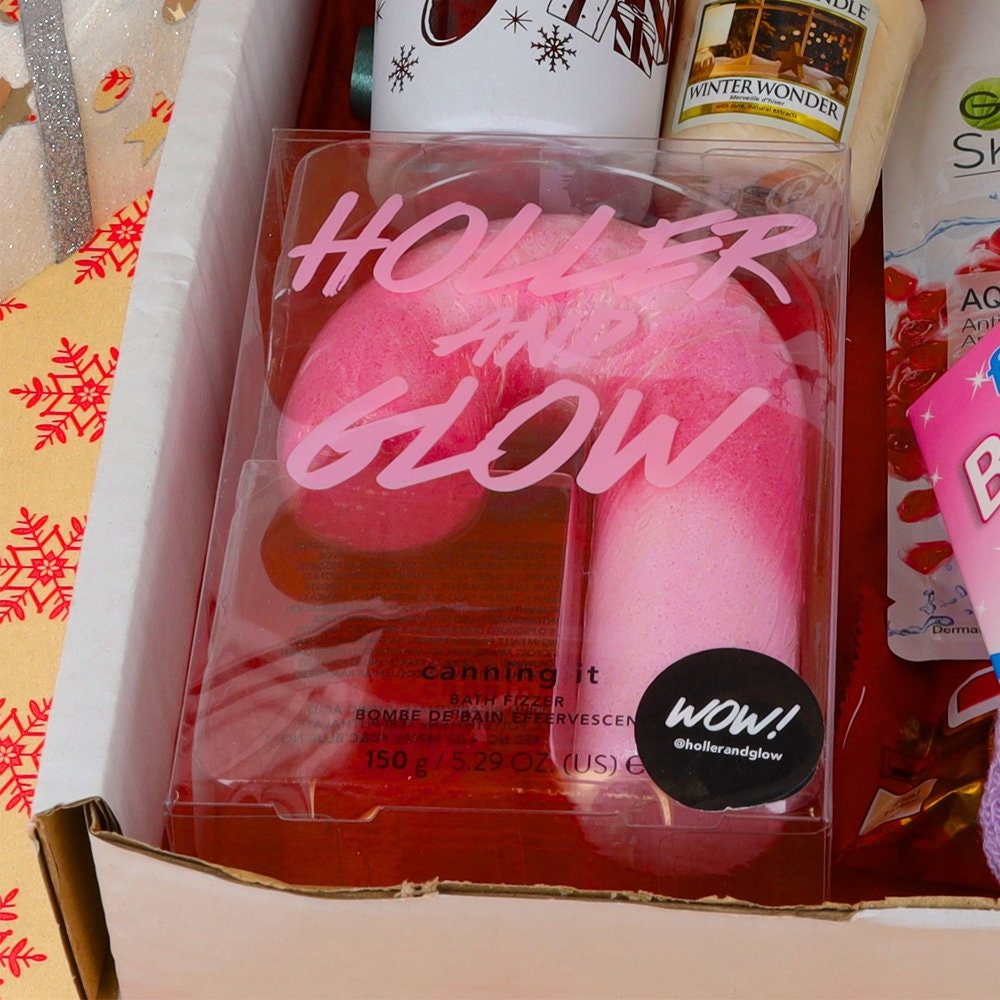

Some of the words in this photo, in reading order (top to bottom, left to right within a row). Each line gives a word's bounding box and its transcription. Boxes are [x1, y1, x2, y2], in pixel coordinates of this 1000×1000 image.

[689, 79, 752, 100] WINTER
[753, 80, 839, 121] WONDER
[287, 191, 817, 305] HOLLER
[432, 307, 639, 369] AND
[286, 376, 771, 495] GLOW
[932, 625, 981, 635] Derma
[421, 663, 558, 689] canning
[576, 663, 600, 685] it
[450, 694, 496, 707] BATH
[503, 694, 565, 708] FIZZER
[355, 708, 421, 722] BOMBE
[429, 710, 452, 722] DE
[460, 711, 504, 724] BAIN
[665, 697, 801, 741] WOW!
[673, 737, 783, 761] @hollerandglow
[365, 750, 408, 769] 150
[415, 757, 428, 778] g
[450, 752, 503, 772] 5.29
[563, 754, 618, 776] (US)
